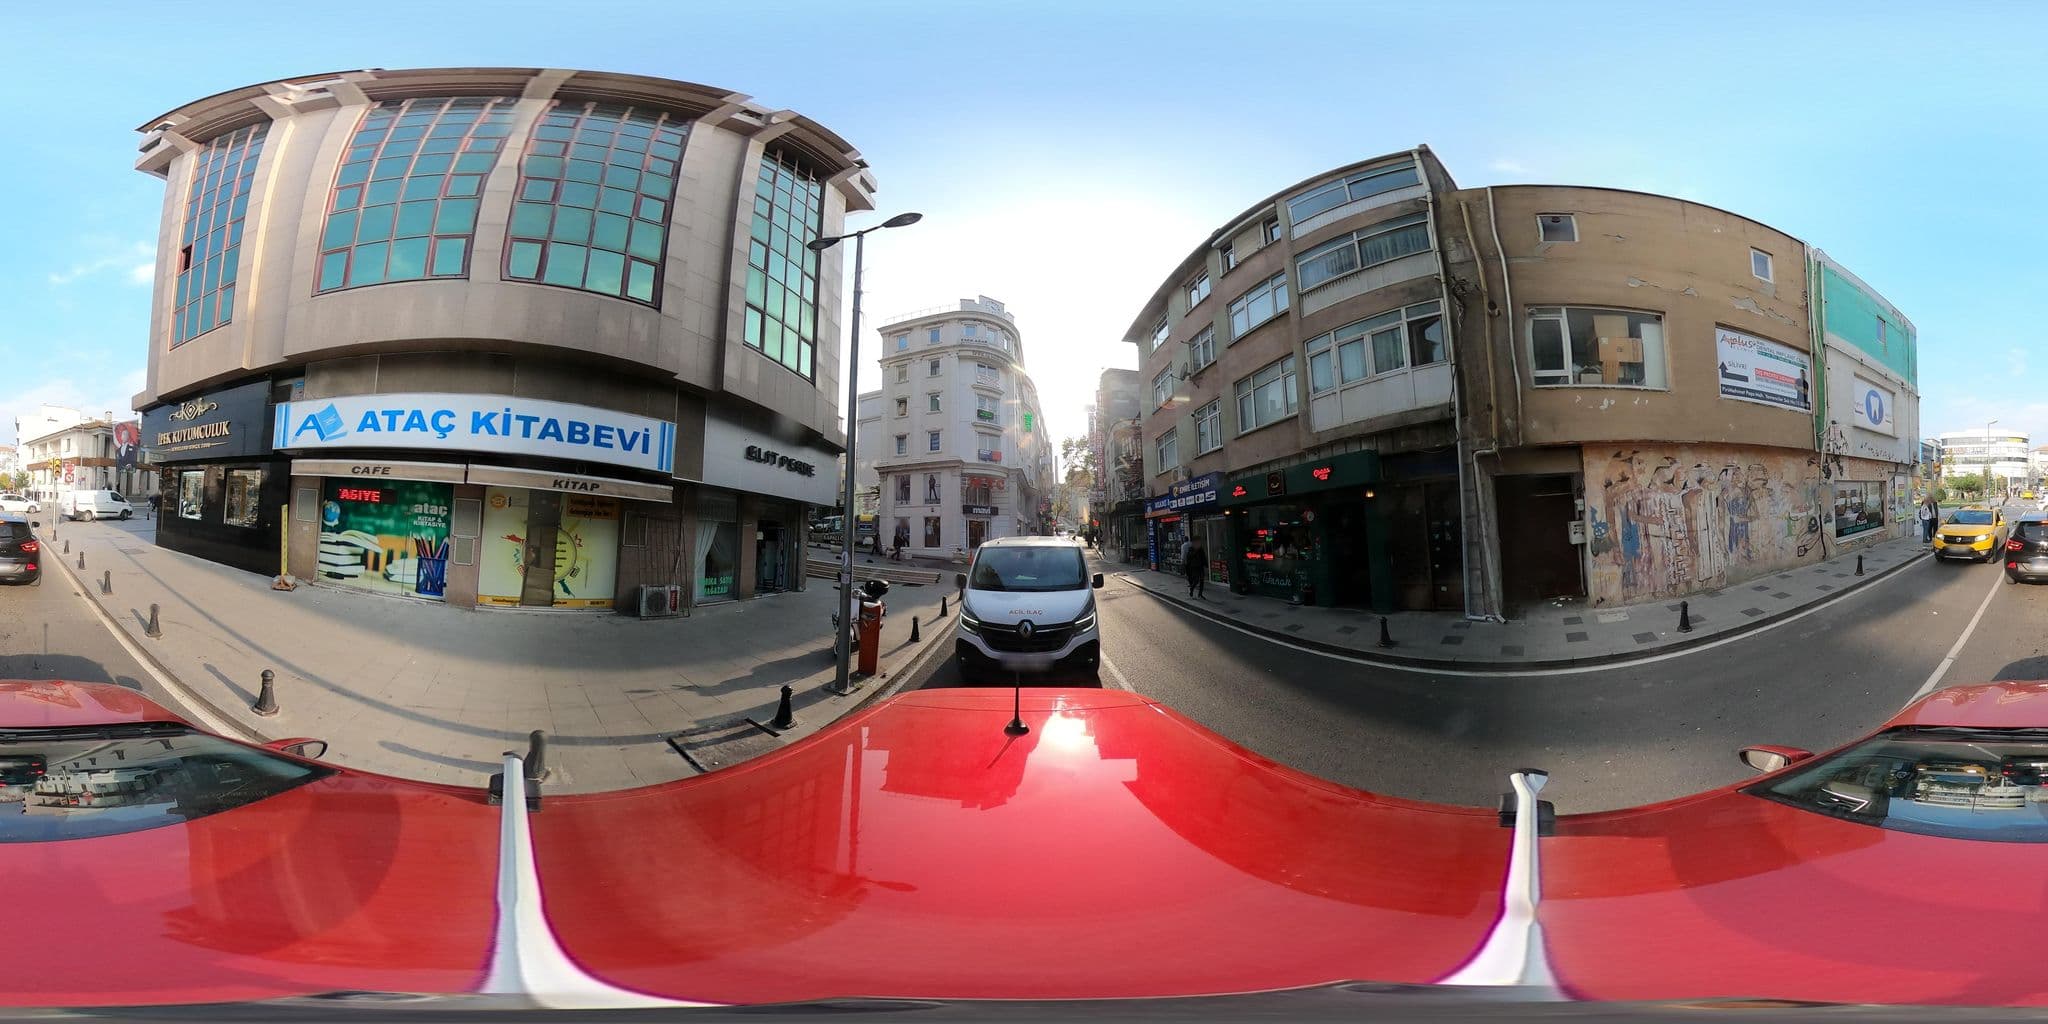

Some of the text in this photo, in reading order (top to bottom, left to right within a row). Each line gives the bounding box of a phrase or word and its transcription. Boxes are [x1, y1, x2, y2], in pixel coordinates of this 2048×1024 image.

[172, 421, 231, 443] KUYUMCULUK
[356, 409, 456, 438] ATAÇ
[471, 407, 650, 454] KİTABEVİ
[351, 465, 392, 475] CAFE
[778, 455, 816, 477] PERDE
[553, 479, 600, 491] KİTAP
[413, 502, 448, 517] ataç
